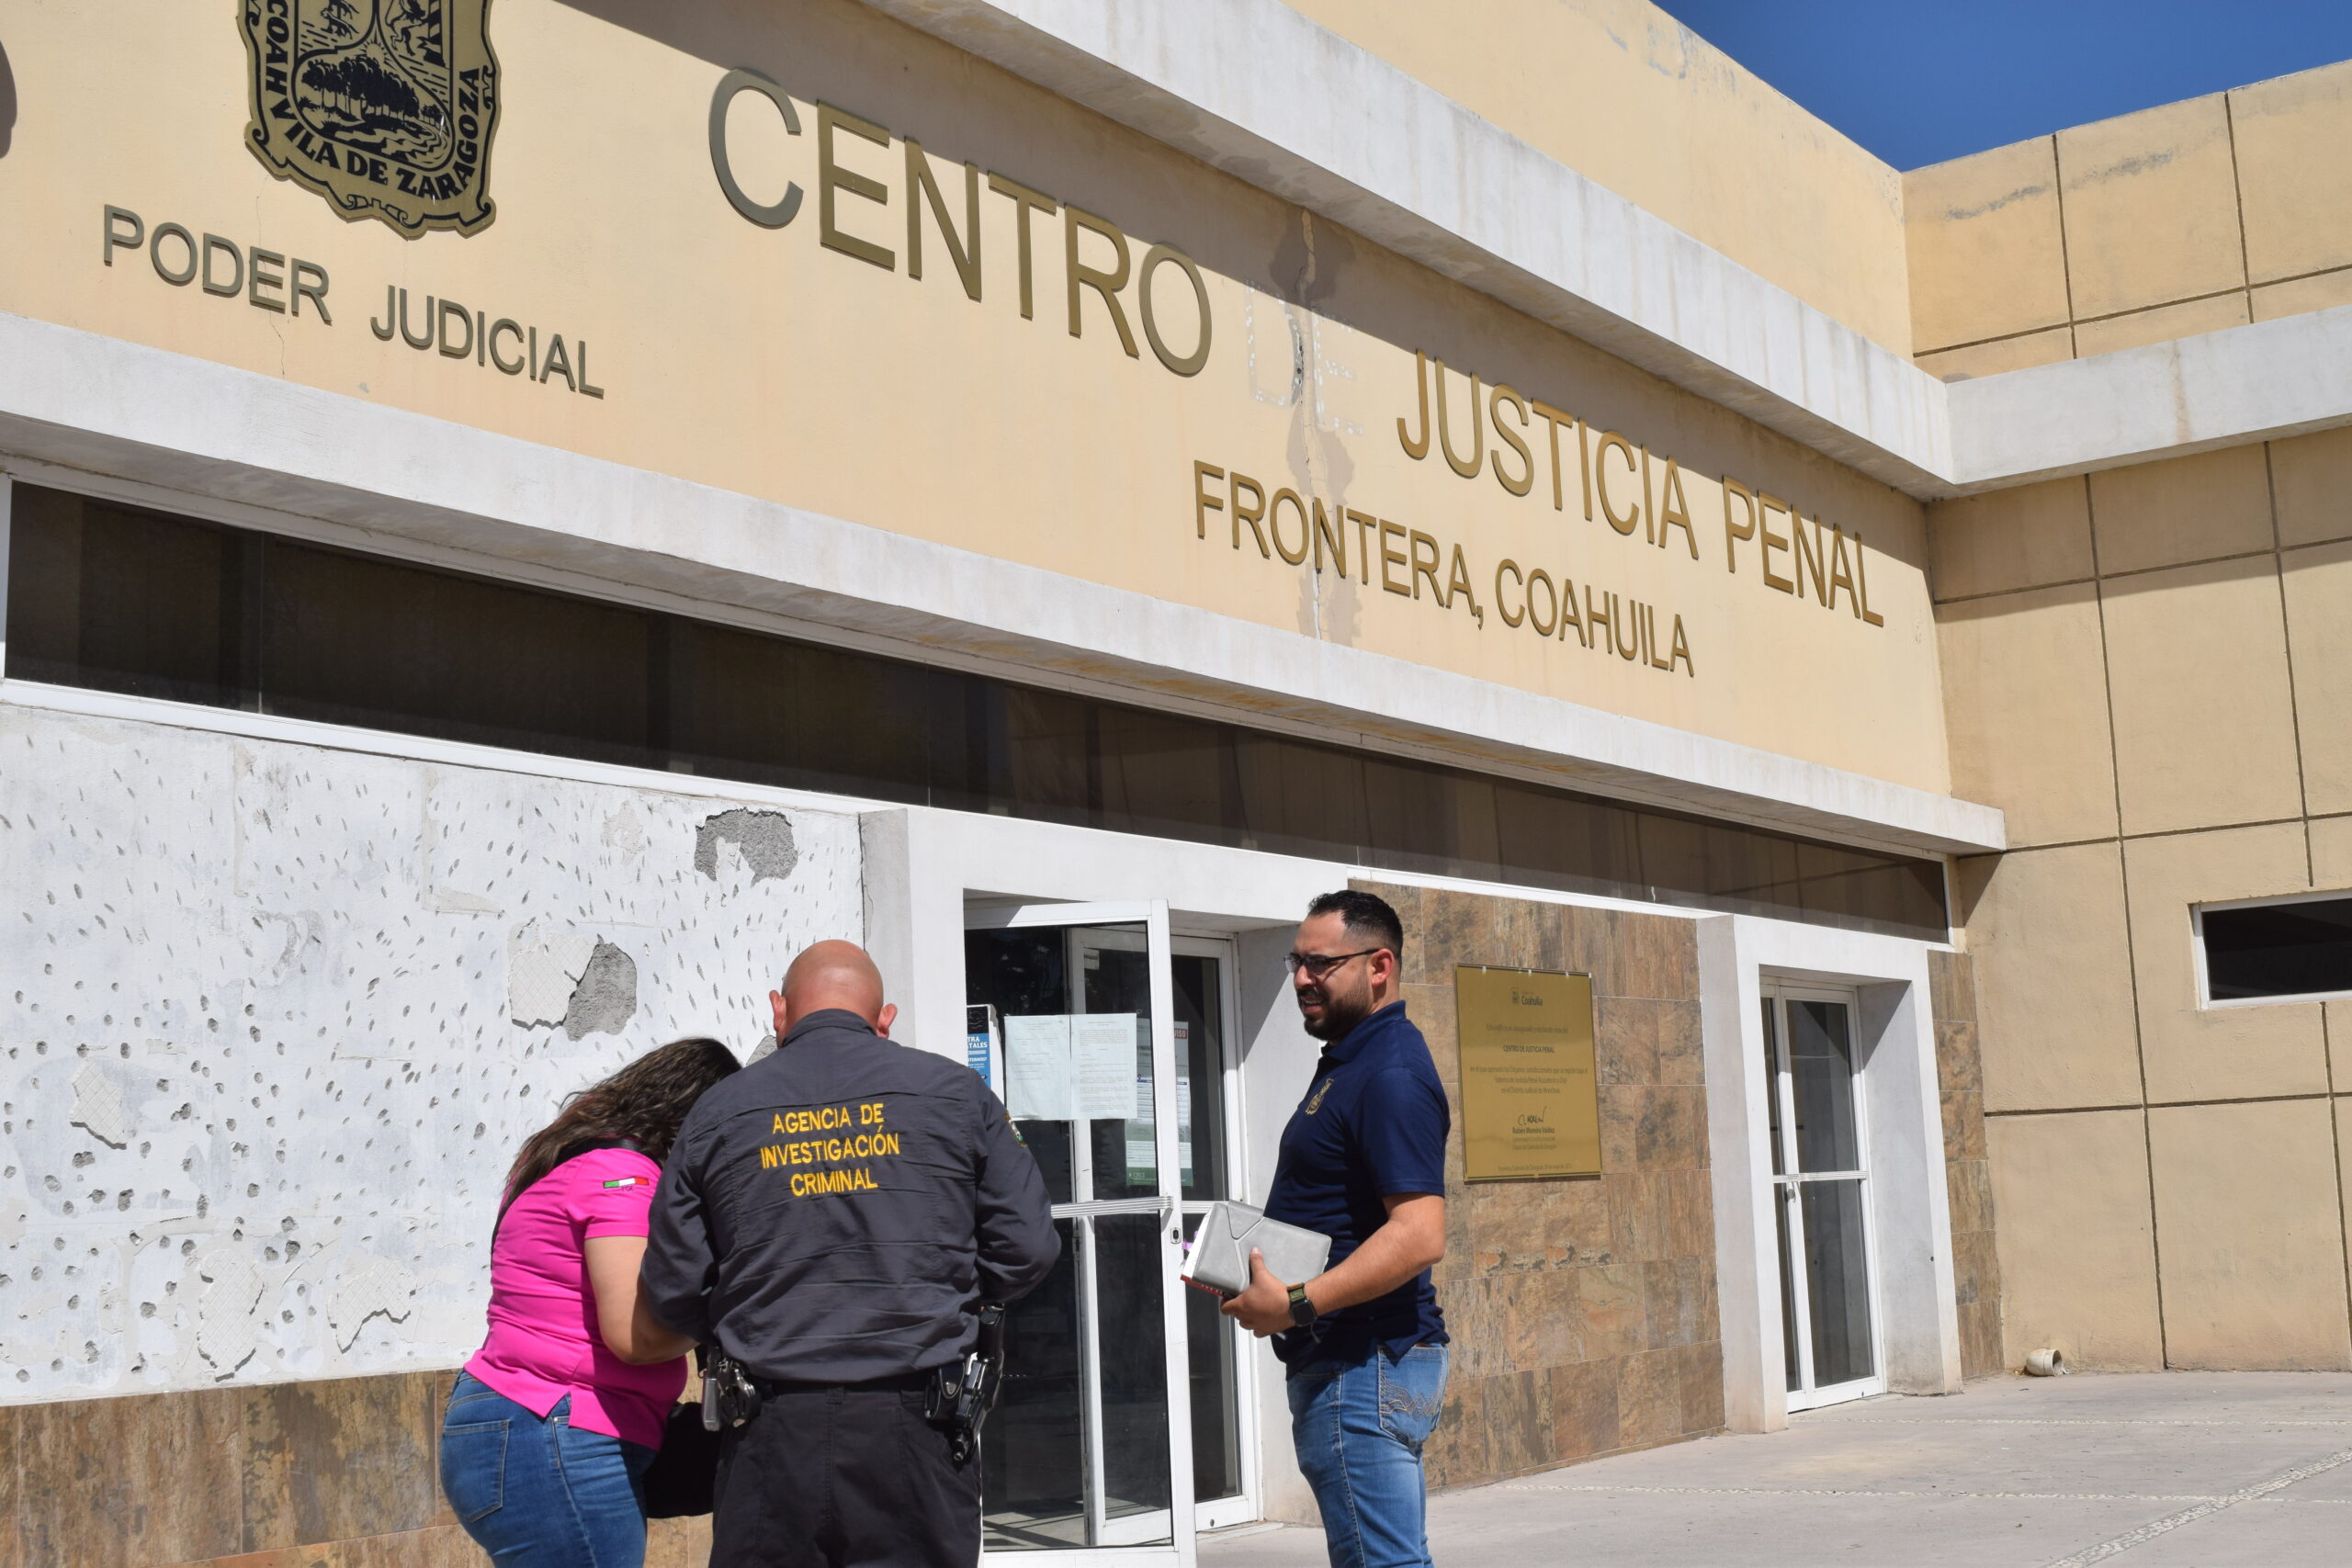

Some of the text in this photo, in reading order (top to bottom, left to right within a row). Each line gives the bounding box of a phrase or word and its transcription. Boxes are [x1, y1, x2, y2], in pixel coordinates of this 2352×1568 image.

[346, 150, 388, 185] DE
[396, 68, 480, 200] ZARAGOZA
[103, 203, 605, 398] PODER JUDICIAL
[708, 68, 1212, 378] CENTRO
[1396, 348, 1699, 560] JUSTICIA
[1722, 474, 1883, 626] PENAL
[1194, 459, 1695, 678] FRONTERA, COAHUILA
[760, 1125, 899, 1169] INVESTIGACIÓN
[773, 1102, 884, 1134] AGENCIA DE
[790, 1168, 879, 1197] CRIMINAL
